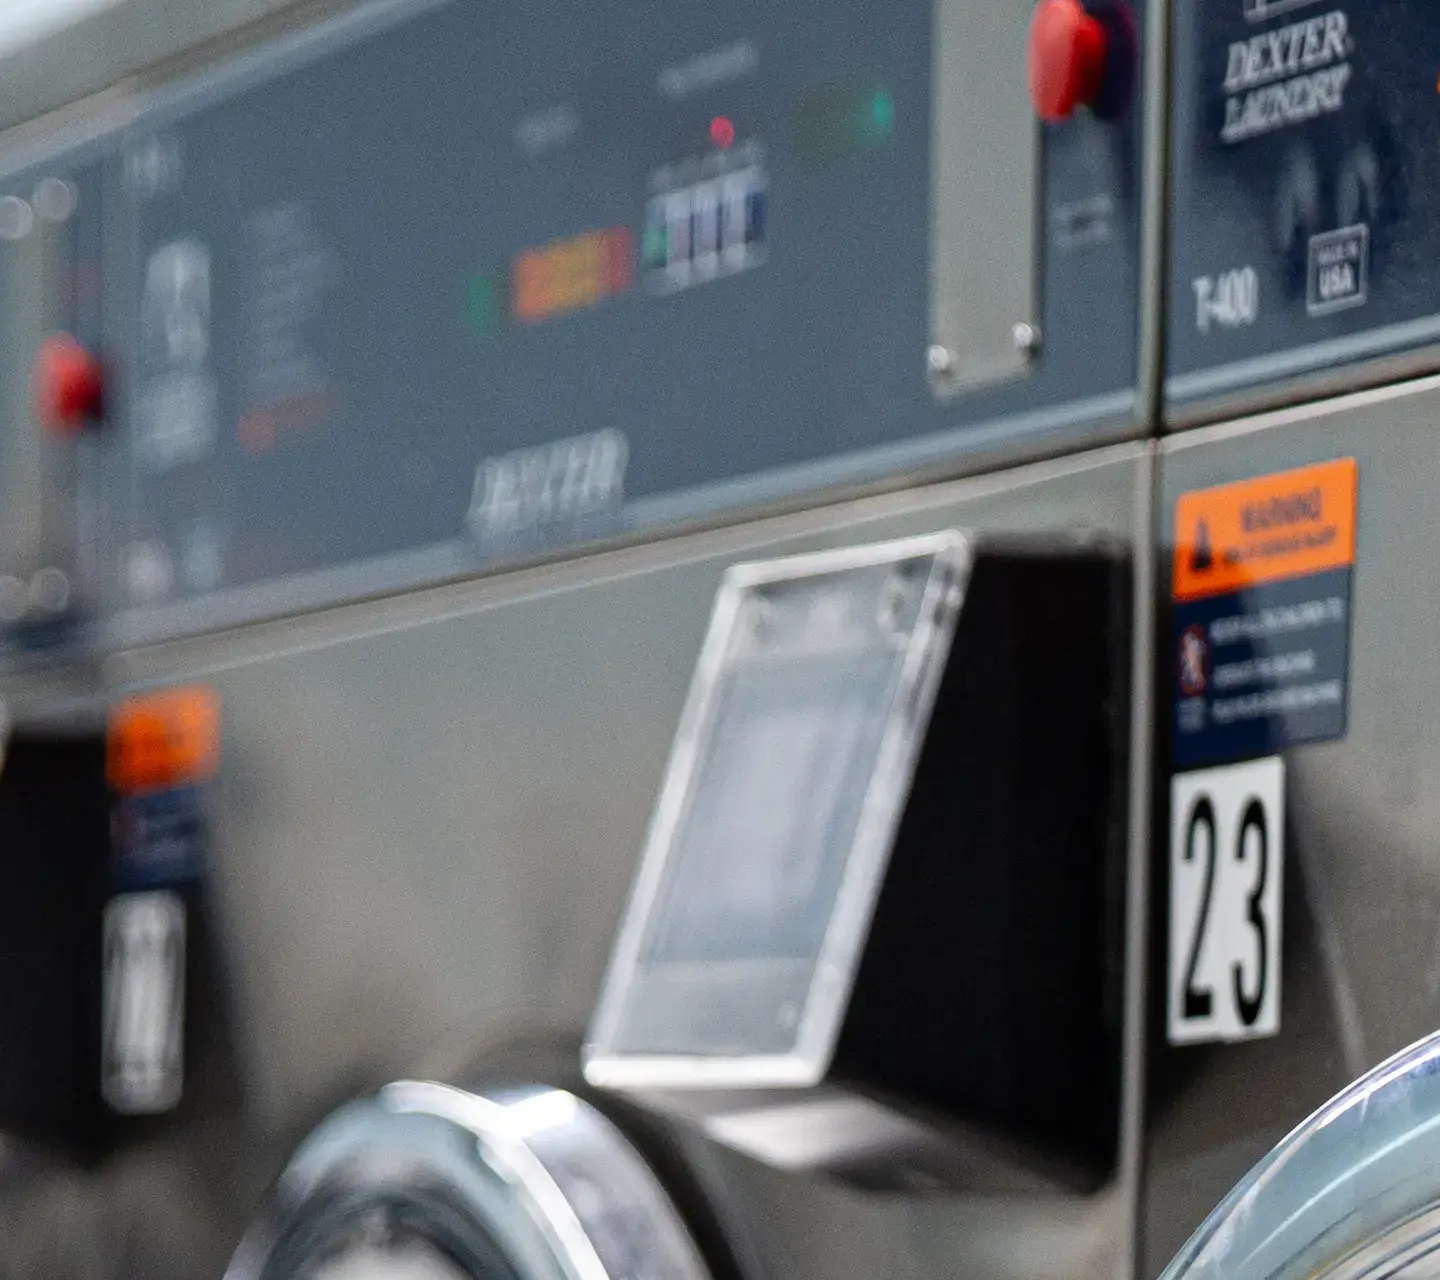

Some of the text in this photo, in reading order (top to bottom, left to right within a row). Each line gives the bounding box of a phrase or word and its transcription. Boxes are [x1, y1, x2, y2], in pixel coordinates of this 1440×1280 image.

[1222, 10, 1348, 93] DEXTER
[1220, 62, 1352, 144] LAUNDRY
[1192, 264, 1259, 336] T-400
[1319, 262, 1356, 299] USA
[1182, 796, 1269, 1027] 23
